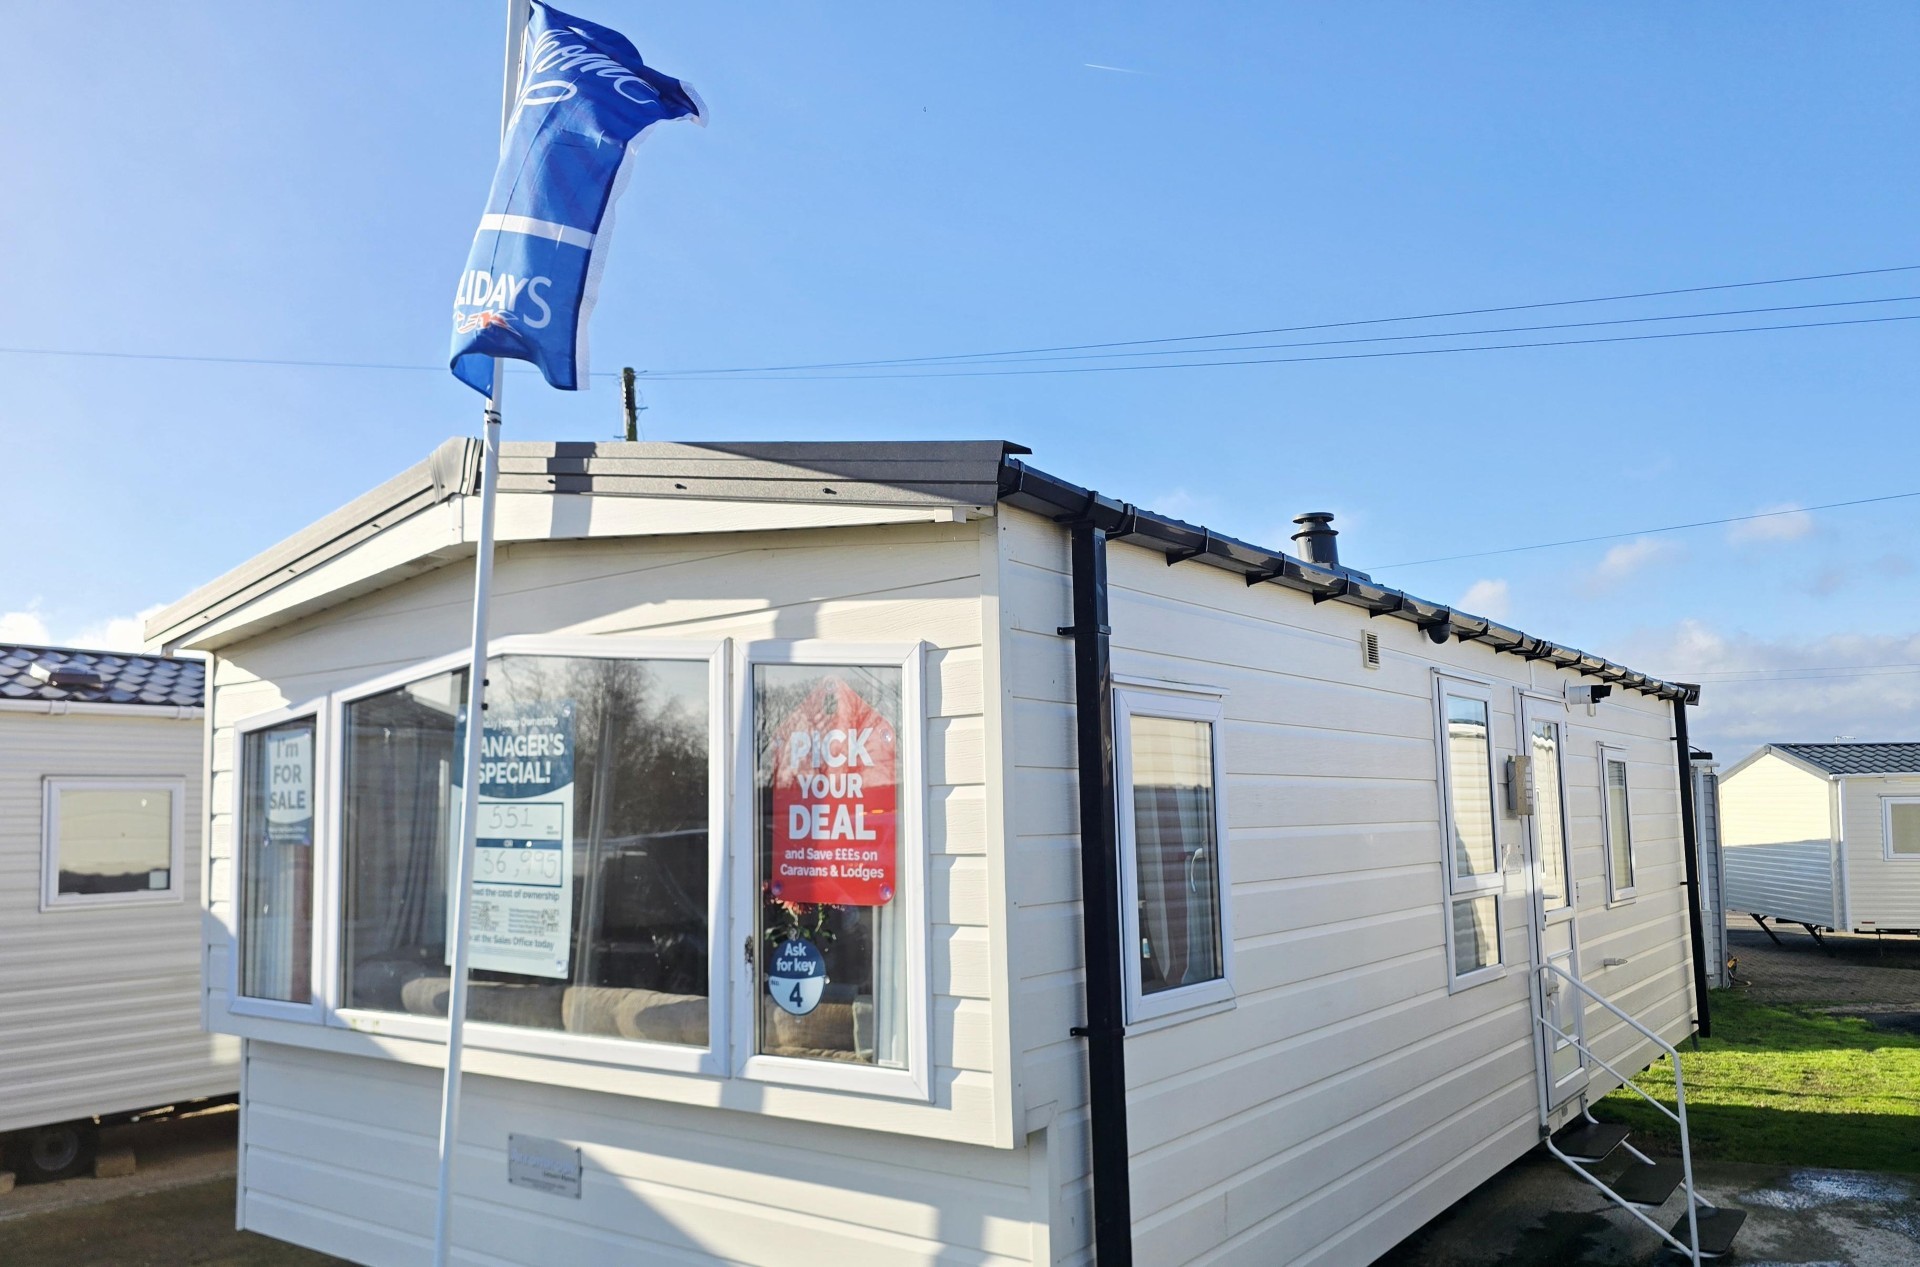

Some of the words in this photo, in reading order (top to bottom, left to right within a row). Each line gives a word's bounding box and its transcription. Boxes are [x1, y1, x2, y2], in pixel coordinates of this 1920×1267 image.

[453, 269, 552, 329] LIDAYS
[276, 738, 299, 758] I'm
[481, 733, 565, 757] ANAGER'S
[790, 727, 874, 769] PICK
[273, 765, 302, 784] FOR
[479, 761, 551, 784] SPECIAL!
[797, 773, 863, 799] YOUR
[270, 791, 306, 809] SALE
[489, 806, 533, 829] 551
[789, 804, 876, 840] DEAL
[482, 850, 557, 879] 36,995
[785, 850, 804, 860] and
[806, 849, 832, 860] Save
[862, 852, 878, 861] on
[780, 864, 828, 876] Caravans
[830, 865, 838, 876] &
[841, 865, 884, 881] Lodges
[784, 942, 807, 957] Ask
[776, 957, 793, 972] for
[794, 958, 817, 976] key
[789, 981, 803, 1008] 4
